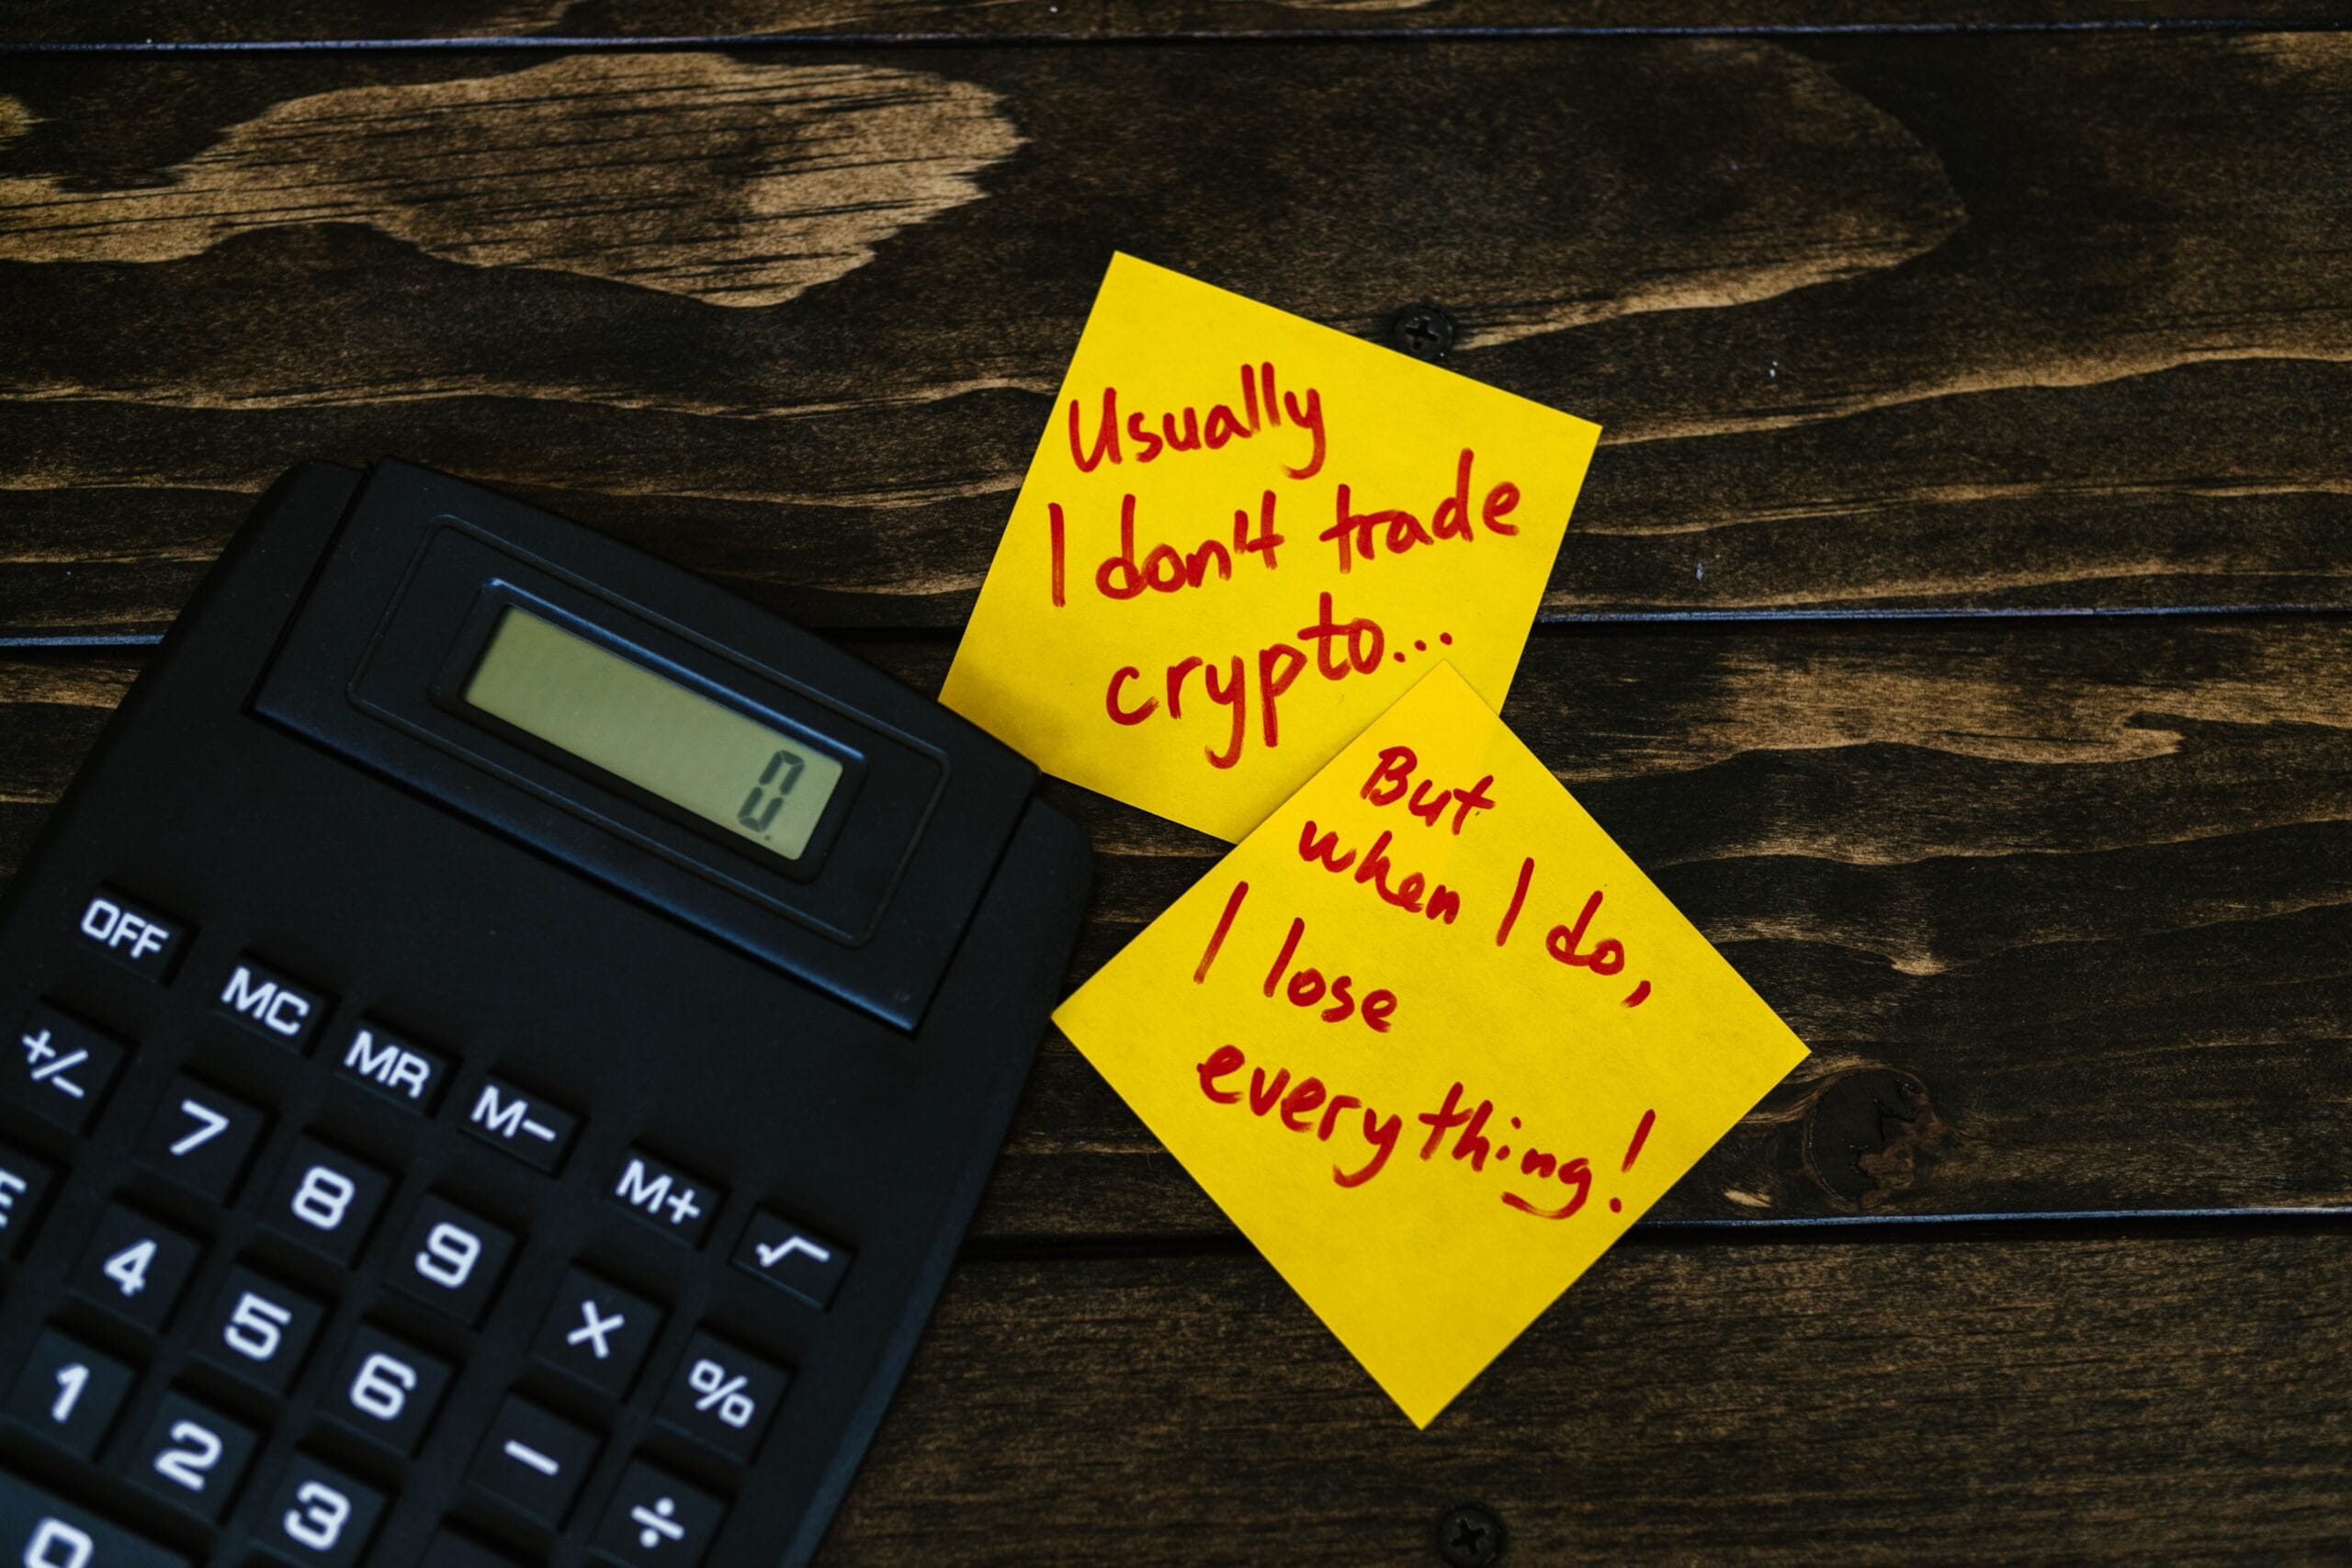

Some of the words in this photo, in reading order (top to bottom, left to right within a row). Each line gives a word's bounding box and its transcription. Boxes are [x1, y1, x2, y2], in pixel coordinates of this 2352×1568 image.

[1068, 360, 1327, 481] Usually
[1046, 501, 1067, 609] I
[1094, 489, 1285, 602] don't
[1317, 447, 1521, 574] trade
[1104, 591, 1453, 771] crypto...
[1359, 744, 1497, 837] But
[81, 898, 169, 958] OFF
[1297, 819, 1462, 926] when
[1495, 855, 1536, 948] I
[1544, 889, 1653, 1010] do,
[1193, 880, 1250, 985] I
[1262, 916, 1398, 1034] lose
[221, 966, 310, 1036] MC
[345, 1030, 430, 1099] MR
[170, 1100, 229, 1155] 7
[1195, 1043, 1657, 1221] everything!
[291, 1166, 355, 1229] 8
[616, 1158, 700, 1224] M+
[104, 1240, 156, 1294] 4
[415, 1223, 481, 1288] 9
[224, 1292, 291, 1359] 5
[52, 1365, 89, 1421] 1
[350, 1353, 416, 1419] 6
[689, 1359, 754, 1427] %
[155, 1421, 222, 1490] 2
[284, 1482, 350, 1550] 3
